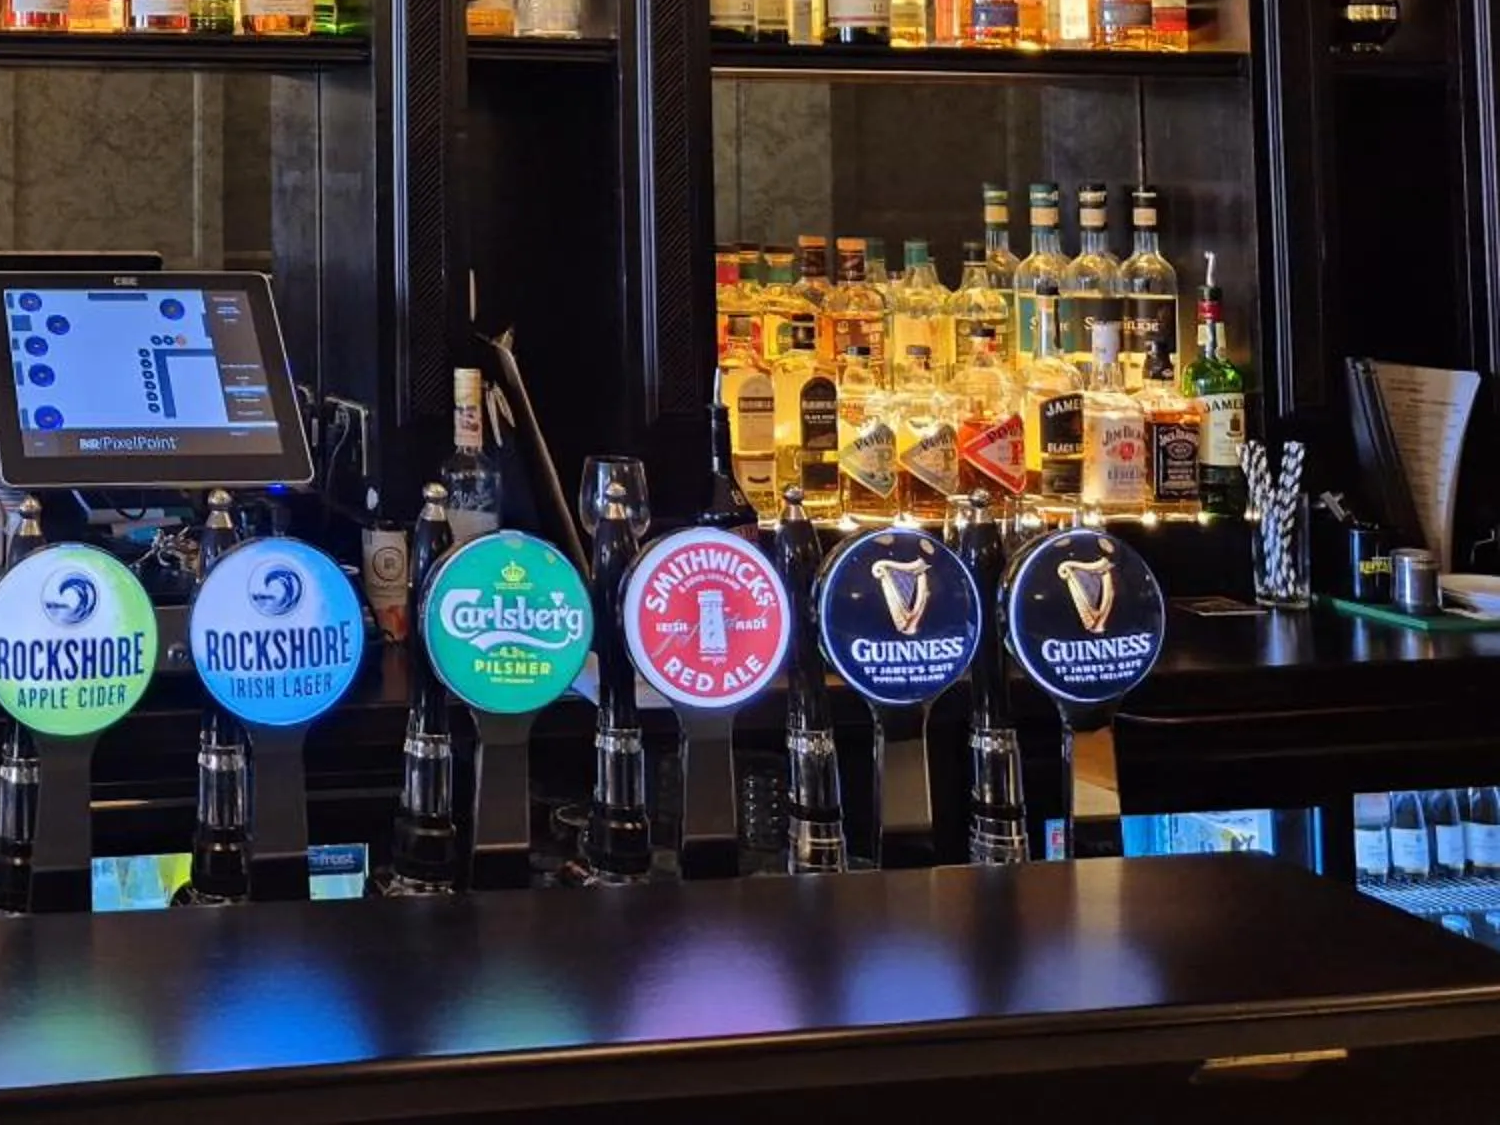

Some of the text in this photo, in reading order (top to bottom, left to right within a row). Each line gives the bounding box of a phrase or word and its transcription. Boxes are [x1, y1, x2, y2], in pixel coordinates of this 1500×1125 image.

[1046, 396, 1085, 417] JAME
[1204, 398, 1246, 413] JAME
[440, 588, 584, 647] Carlsberg
[205, 620, 352, 672] ROCKSHORE
[851, 637, 965, 663] GUINNESS
[1041, 633, 1153, 663] GUINNESS
[473, 658, 552, 676] PILSNER
[663, 654, 765, 692] RED ALE
[17, 684, 127, 709] APPLE CIDER
[230, 672, 333, 699] IRISH LAGER
